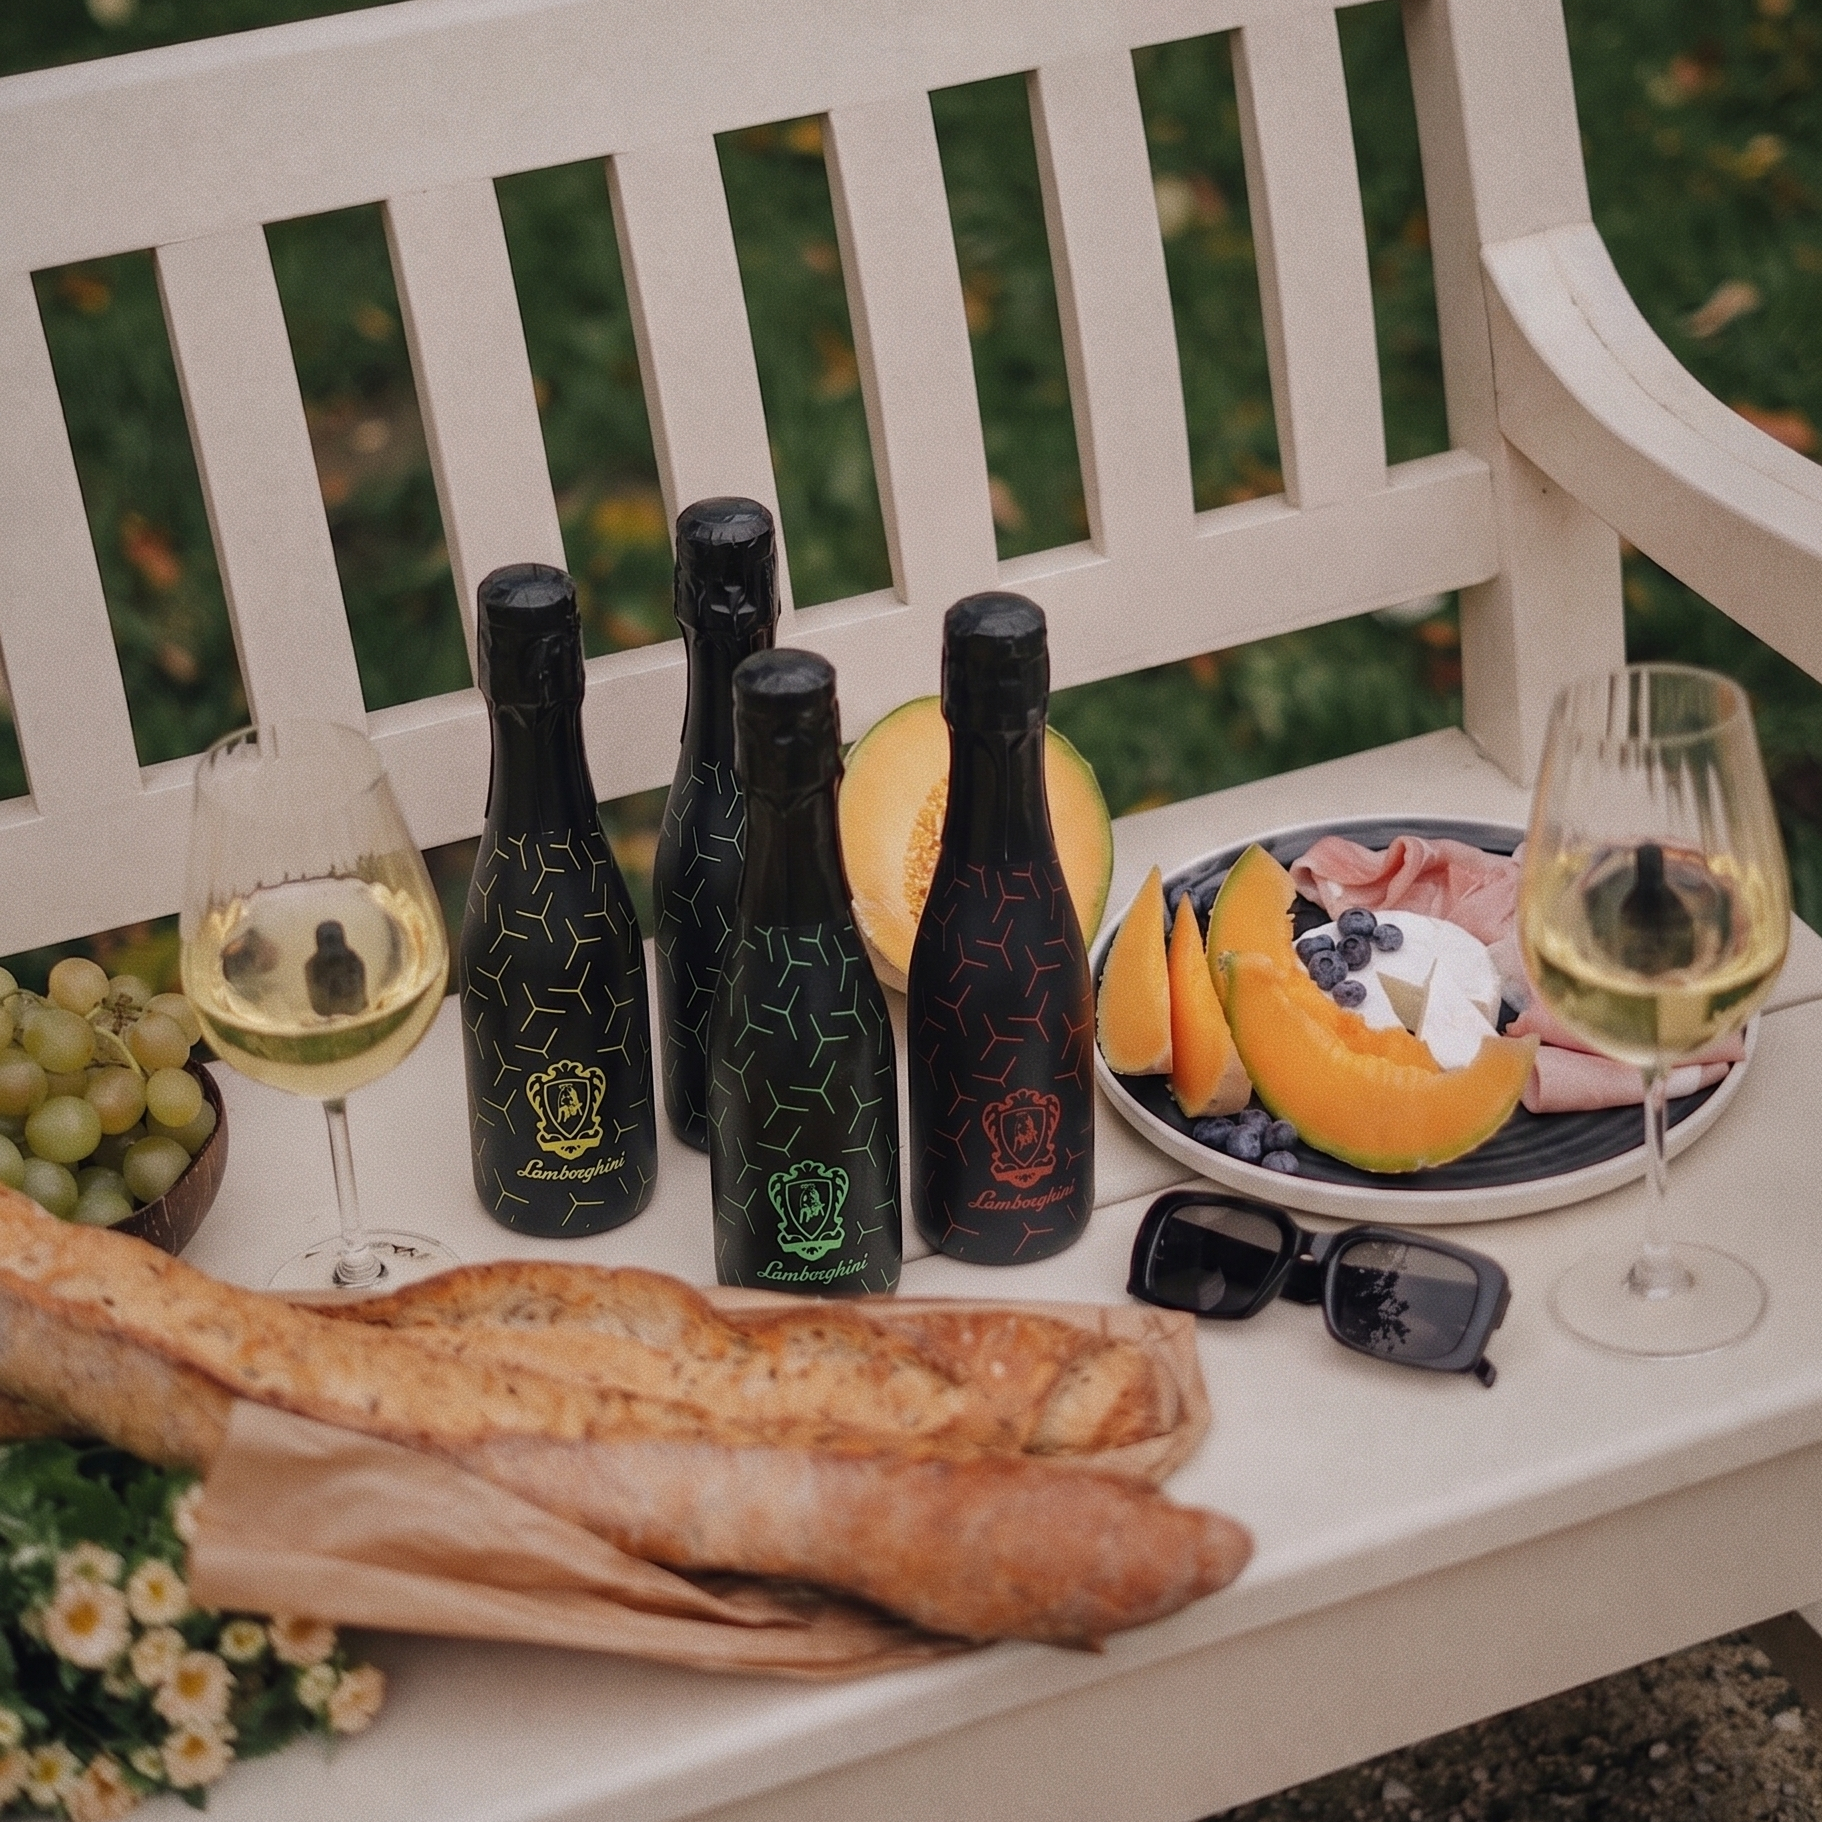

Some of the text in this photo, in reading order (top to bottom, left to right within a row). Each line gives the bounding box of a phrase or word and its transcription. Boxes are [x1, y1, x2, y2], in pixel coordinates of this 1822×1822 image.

[517, 1151, 626, 1184] Lamborghini
[966, 1177, 1076, 1213] Lamborghini
[756, 1252, 869, 1285] Lamborghini
